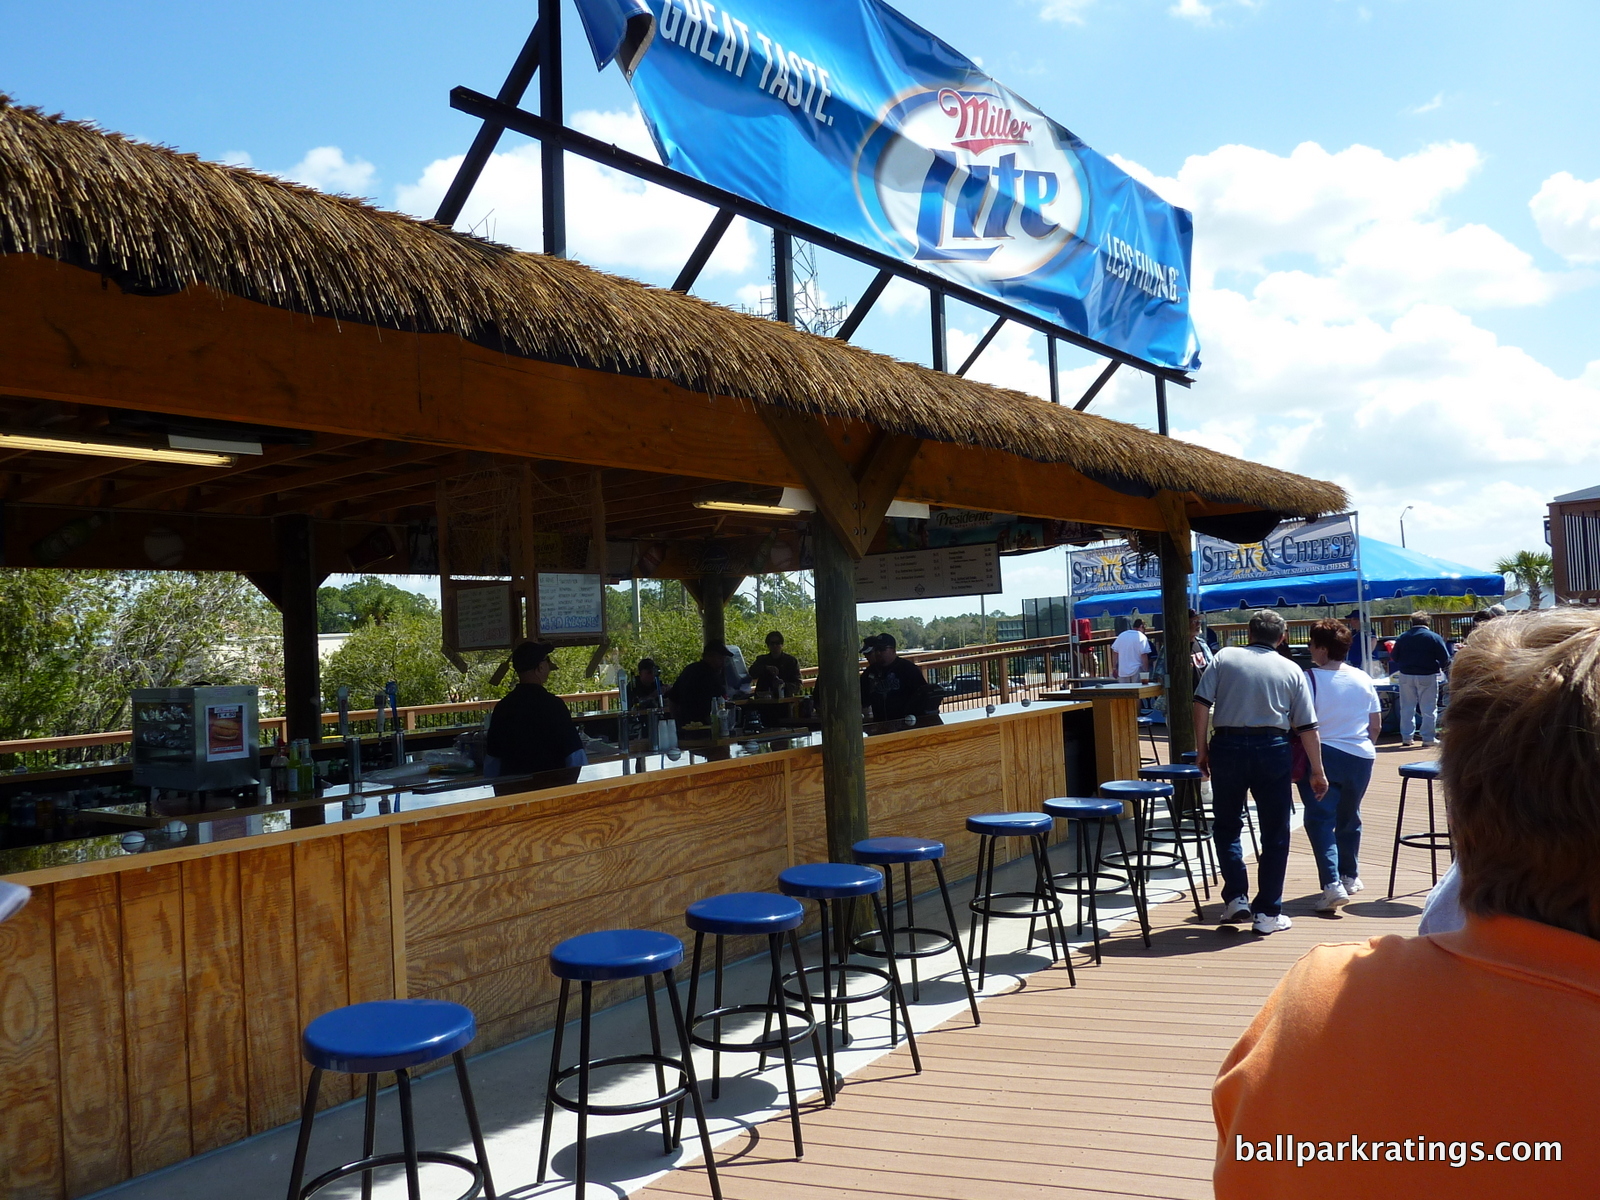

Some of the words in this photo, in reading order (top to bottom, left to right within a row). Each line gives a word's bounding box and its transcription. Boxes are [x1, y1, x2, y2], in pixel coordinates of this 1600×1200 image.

[659, 0, 750, 78] GREAT
[756, 31, 834, 126] TASTE.
[937, 87, 1032, 140] Miller
[911, 148, 1061, 263] Lite
[1105, 232, 1134, 282] LESS
[936, 511, 993, 526] Presidente
[1072, 560, 1116, 585] STEAK
[1120, 556, 1131, 581] &
[1202, 545, 1257, 574] STEAK
[1261, 539, 1277, 568] &
[1281, 535, 1354, 565] CHEESE
[1283, 565, 1320, 576] MUSHROOMS
[1325, 561, 1350, 571] CHEESE
